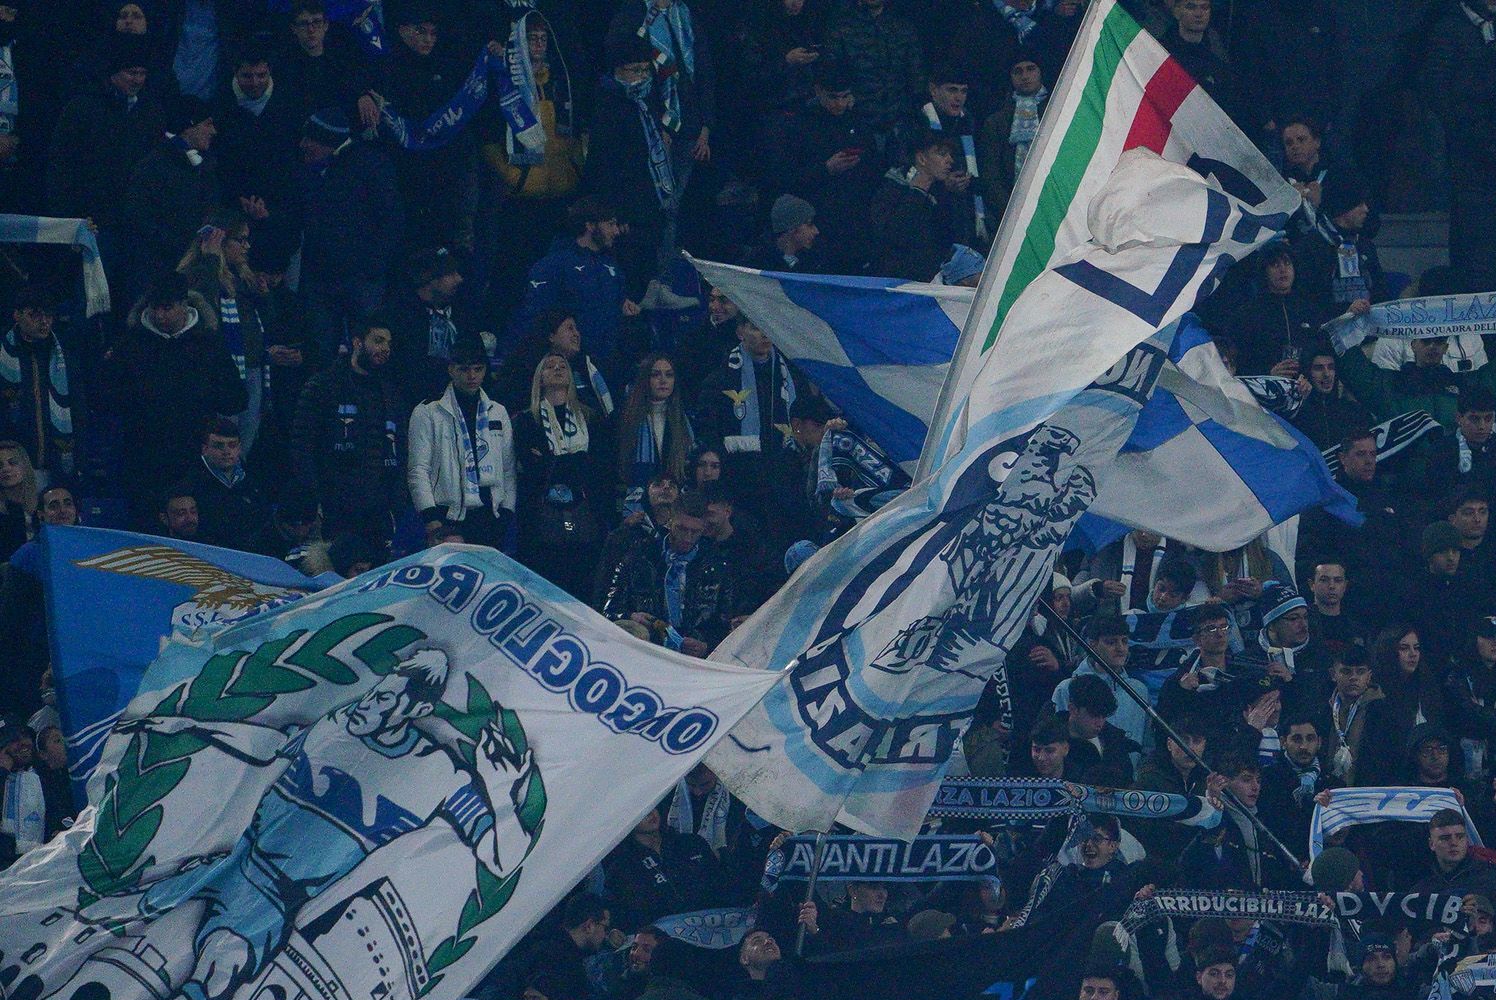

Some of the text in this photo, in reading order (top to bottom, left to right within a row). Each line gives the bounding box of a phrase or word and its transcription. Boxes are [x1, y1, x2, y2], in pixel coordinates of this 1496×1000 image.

[1391, 326, 1425, 336] PRIMA
[1426, 323, 1473, 335] SQUADRA
[979, 787, 1052, 807] LAZIO
[785, 842, 996, 874] AVANTI LAZIO
[1154, 896, 1284, 914] IRRIDUCIBILI
